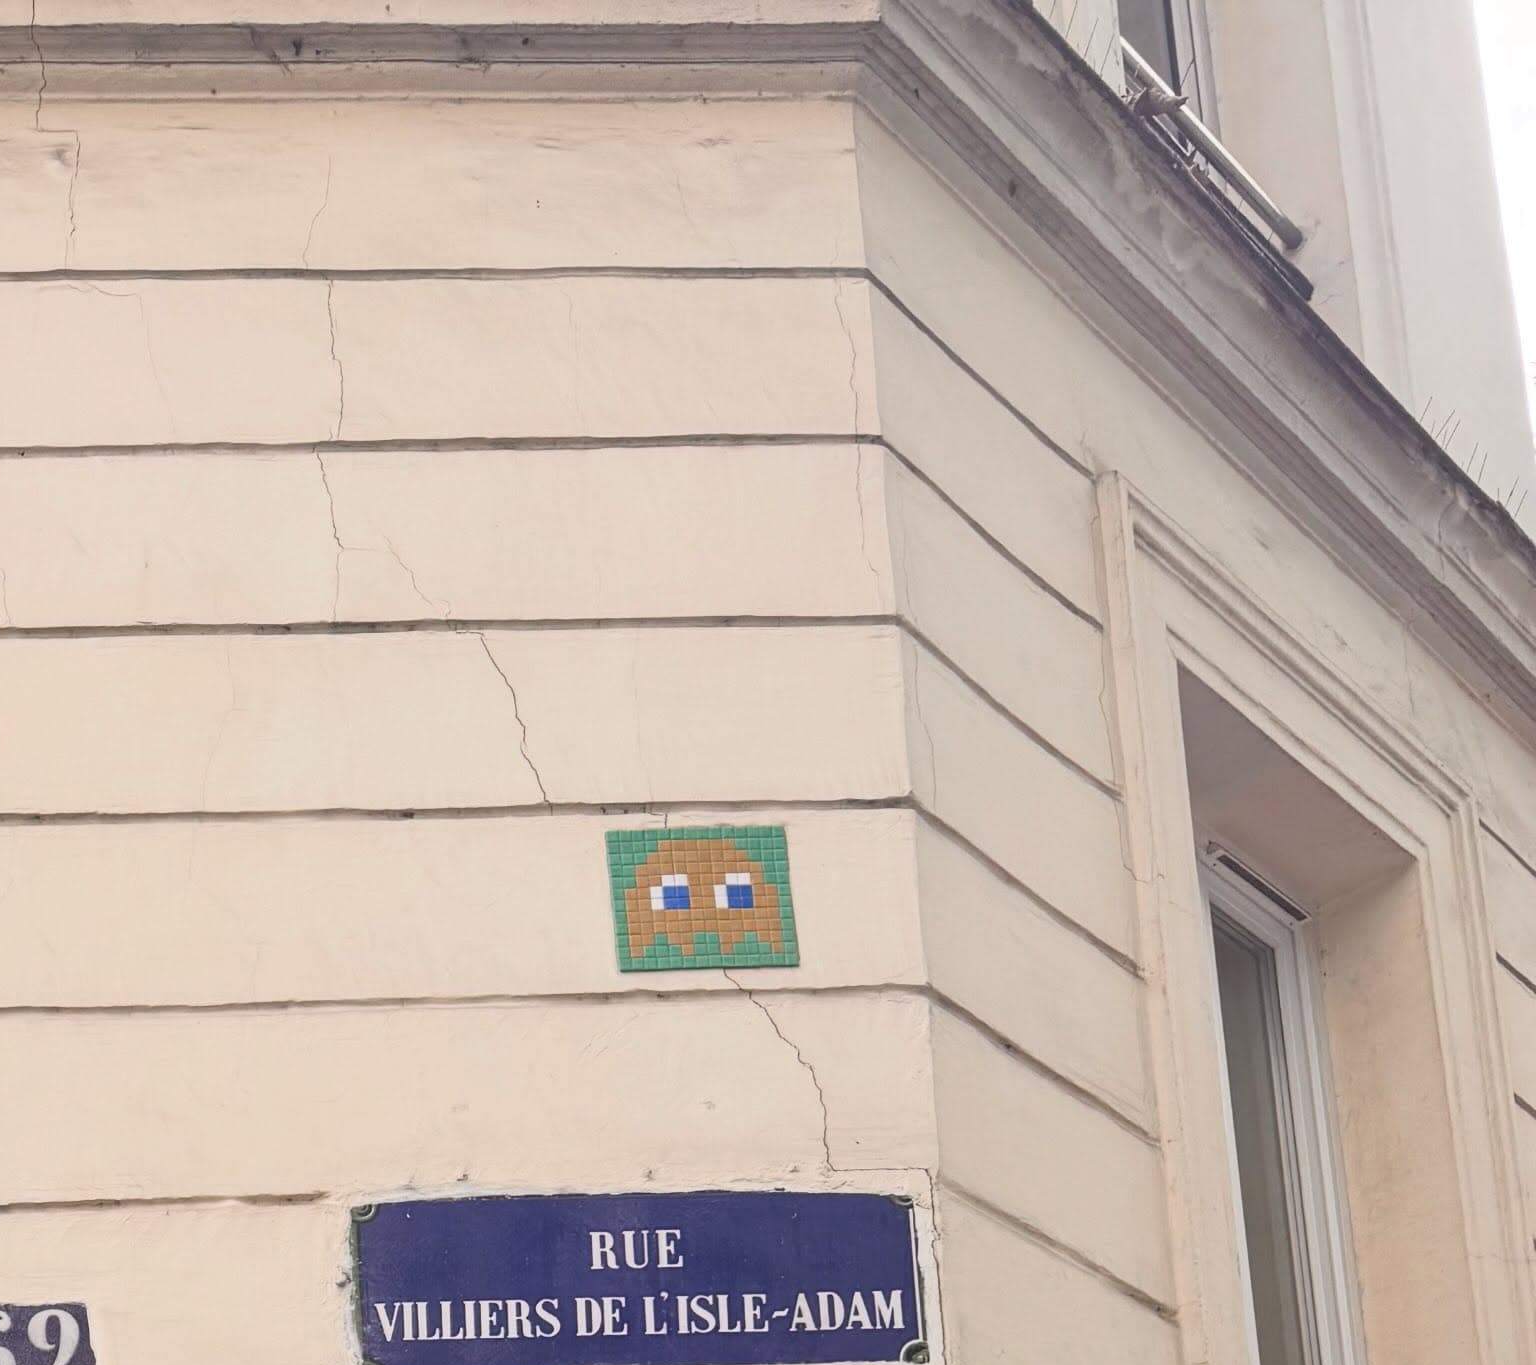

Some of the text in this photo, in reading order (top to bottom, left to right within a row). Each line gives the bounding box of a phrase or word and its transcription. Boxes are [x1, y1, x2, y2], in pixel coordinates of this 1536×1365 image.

[589, 1229, 684, 1270] RUE
[373, 1289, 906, 1342] VILLIERS DE L'ISLE-ADAM
